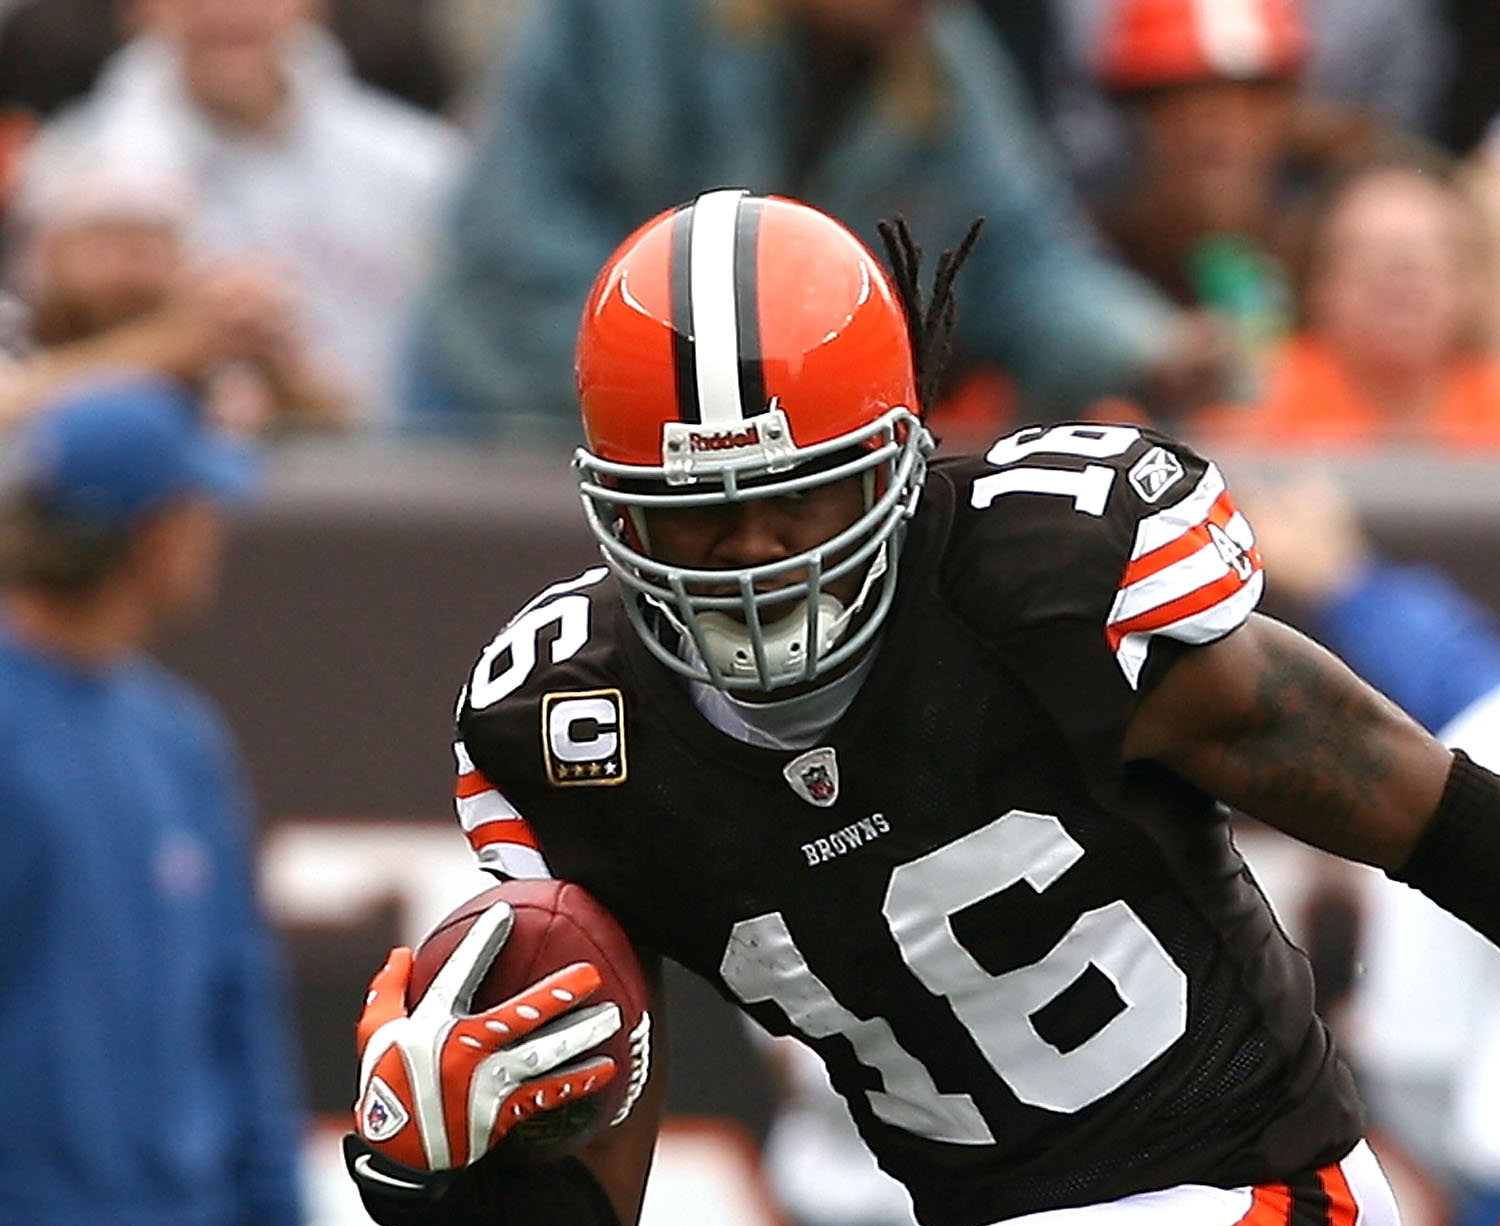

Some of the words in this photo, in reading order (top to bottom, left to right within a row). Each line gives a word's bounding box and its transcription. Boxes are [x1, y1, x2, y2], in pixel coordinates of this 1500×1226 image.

[689, 423, 760, 453] Riddell
[970, 425, 1142, 516] 16
[550, 698, 617, 762] C
[800, 812, 891, 867] BROWNS
[719, 809, 1188, 1145] 16
